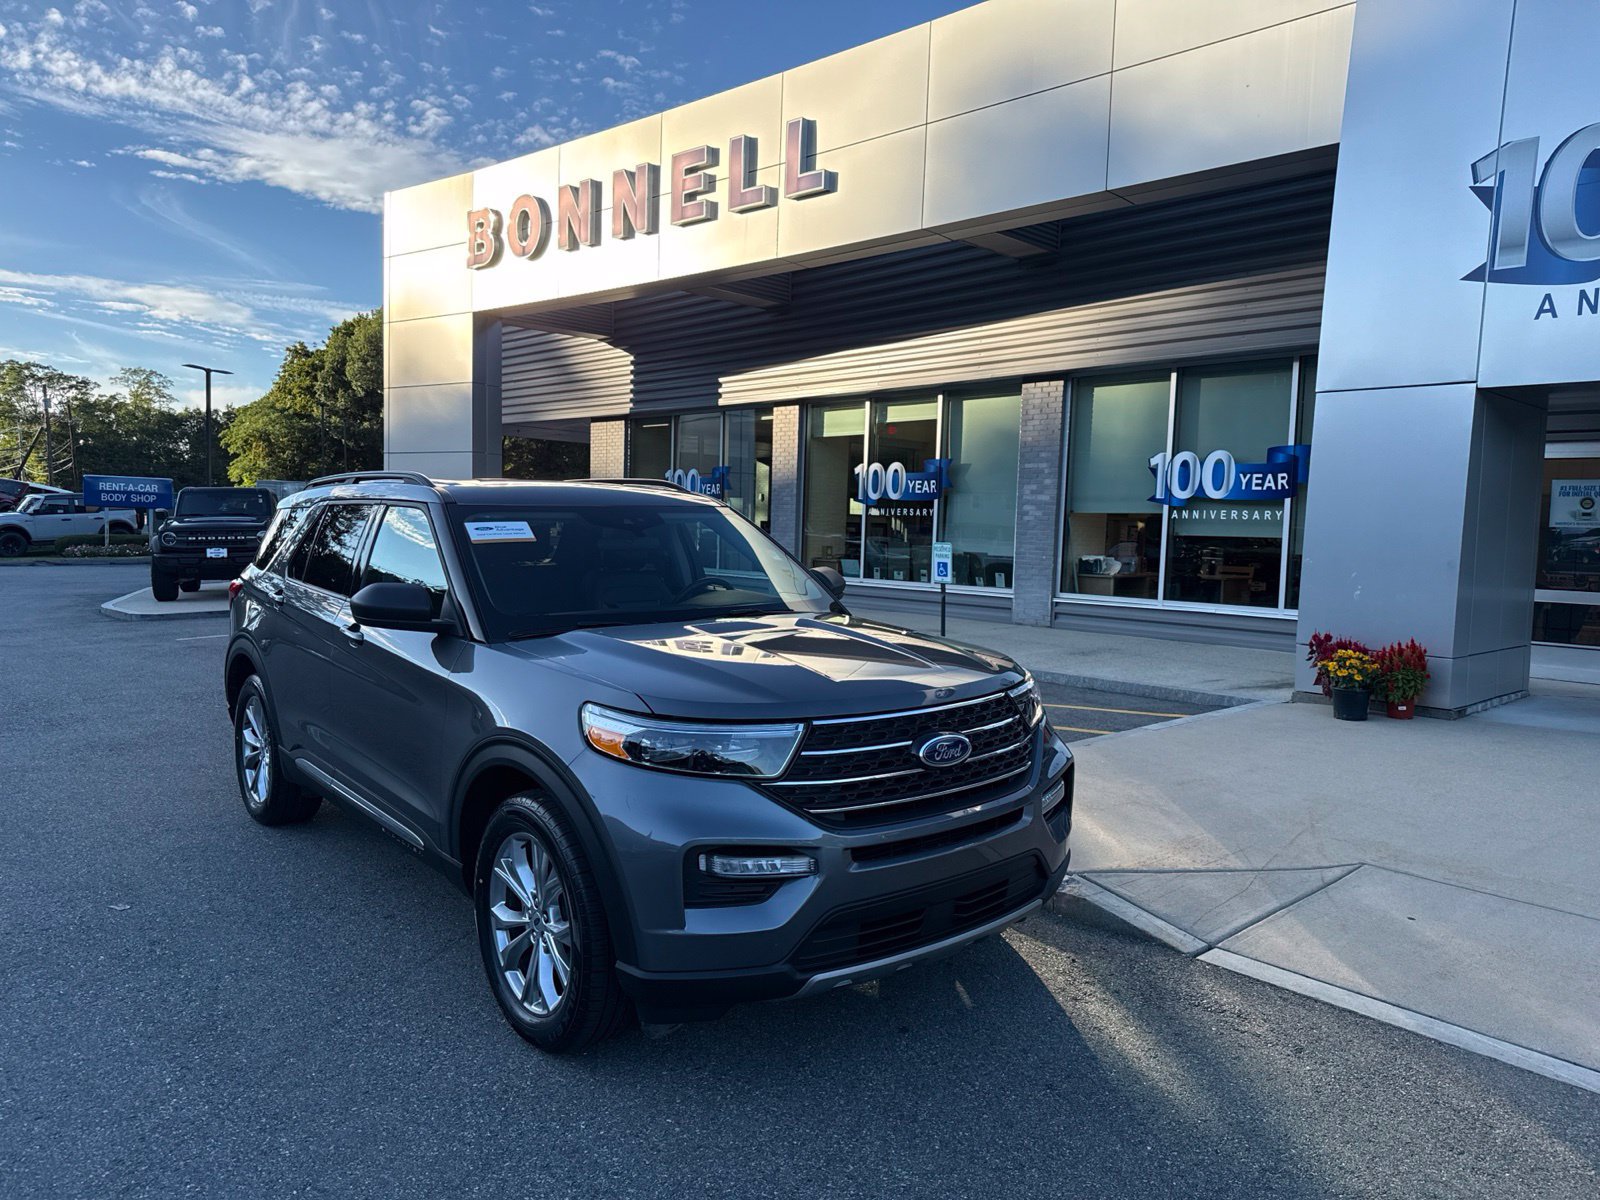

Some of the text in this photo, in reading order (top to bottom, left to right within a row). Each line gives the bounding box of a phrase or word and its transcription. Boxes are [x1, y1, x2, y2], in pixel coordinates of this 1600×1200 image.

[466, 117, 838, 270] BONNELL
[853, 462, 937, 500] 100 YEAR
[1149, 449, 1289, 500] 100 YEAR
[98, 482, 159, 493] RENT-A-CAR
[701, 483, 721, 495] YEAR
[100, 493, 157, 503] BODY SHOP
[1171, 510, 1283, 520] ANNIVERSARY
[934, 741, 962, 761] Ford
